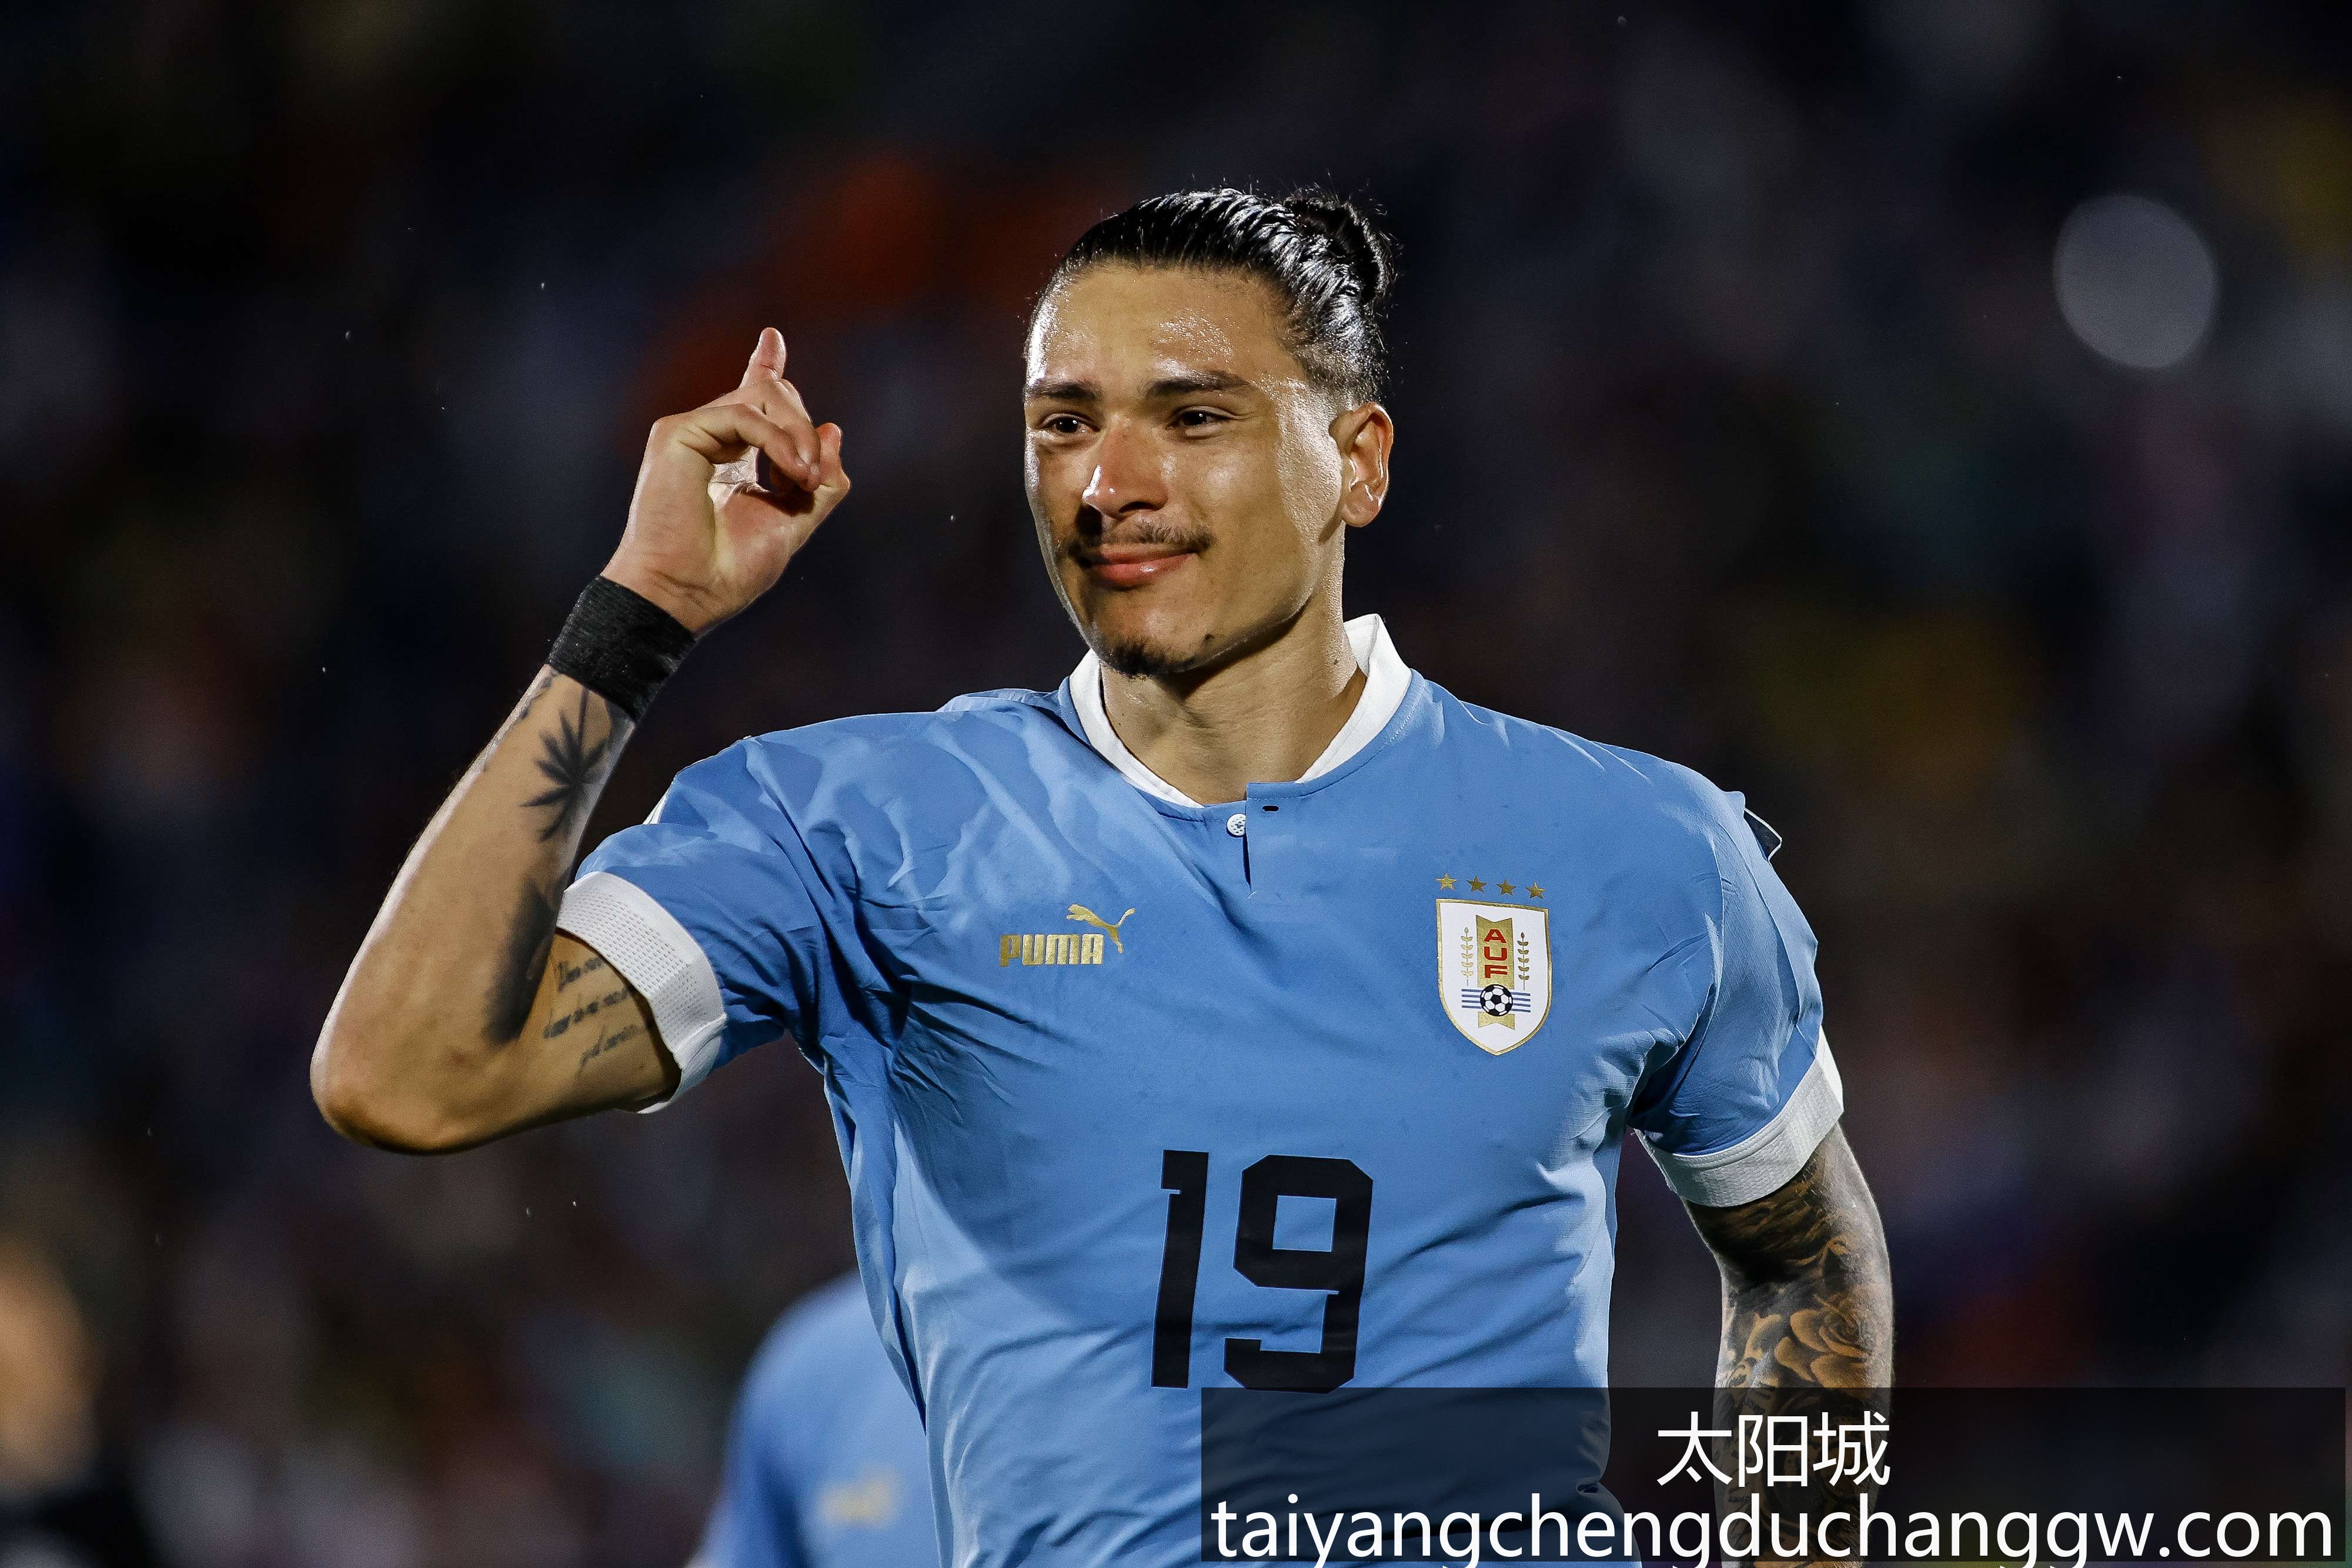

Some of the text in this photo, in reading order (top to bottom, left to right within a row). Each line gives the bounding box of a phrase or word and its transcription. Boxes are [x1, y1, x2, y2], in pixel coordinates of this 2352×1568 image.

[999, 932, 1104, 967] PUMA
[1484, 928, 1508, 979] AUF
[1151, 1149, 1374, 1395] 19
